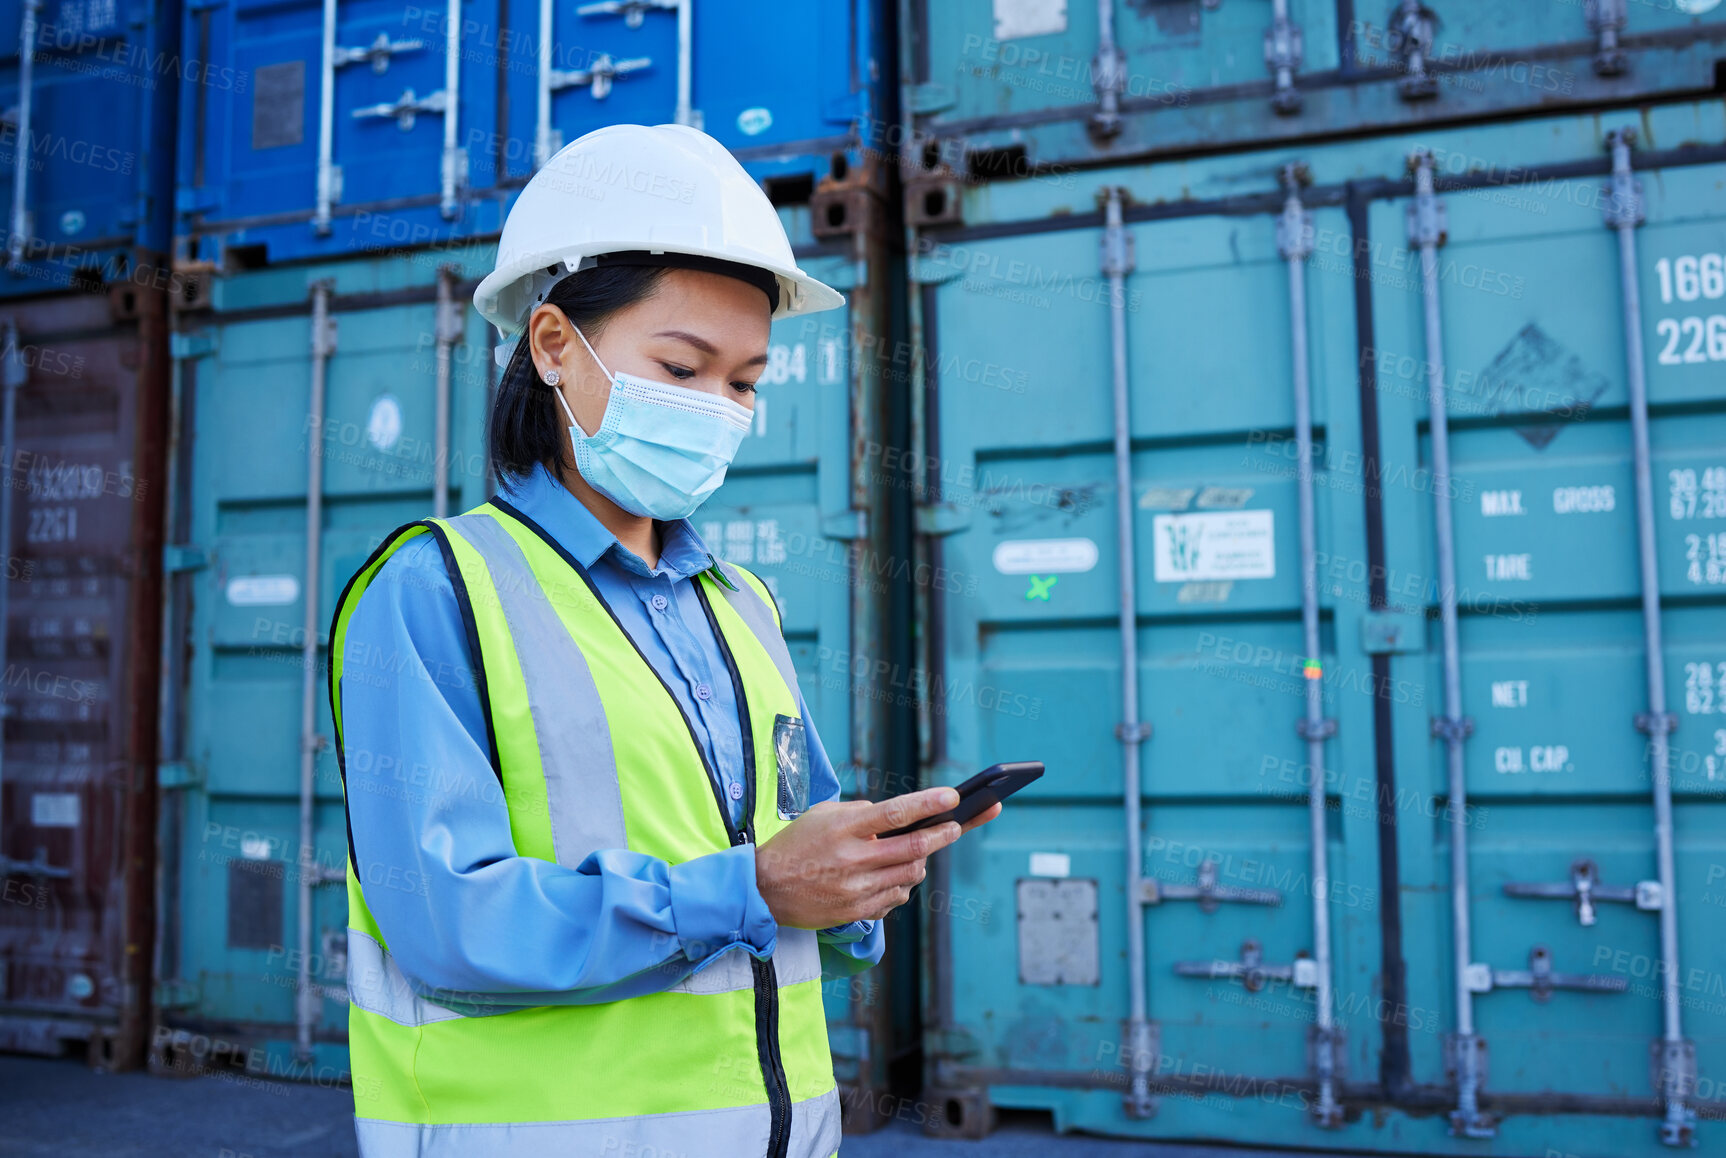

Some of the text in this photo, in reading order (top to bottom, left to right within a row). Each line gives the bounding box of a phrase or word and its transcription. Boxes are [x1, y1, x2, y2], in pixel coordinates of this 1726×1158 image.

[1655, 254, 1726, 304] 166
[1552, 484, 1615, 514] GROSS
[1491, 680, 1529, 707] NET
